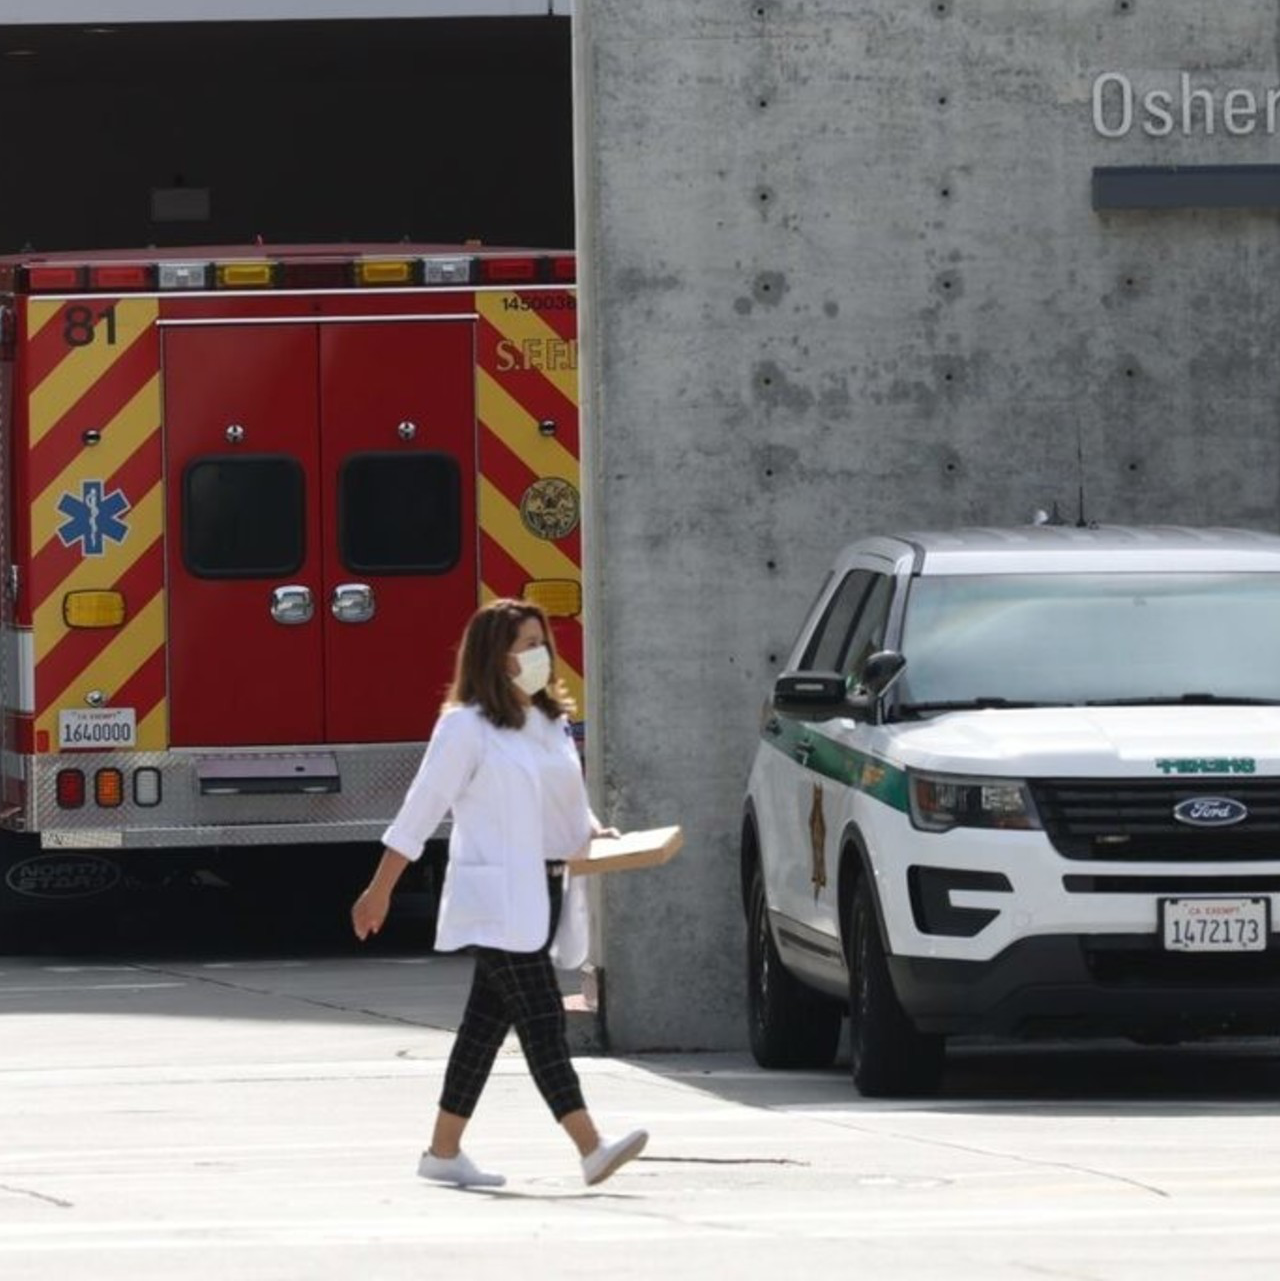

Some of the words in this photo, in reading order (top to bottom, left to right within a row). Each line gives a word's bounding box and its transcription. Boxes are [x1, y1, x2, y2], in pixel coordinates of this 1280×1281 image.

[64, 305, 116, 347] 81
[64, 722, 131, 742] 1640000
[1189, 801, 1232, 818] Ford
[1172, 918, 1259, 944] 1472173
